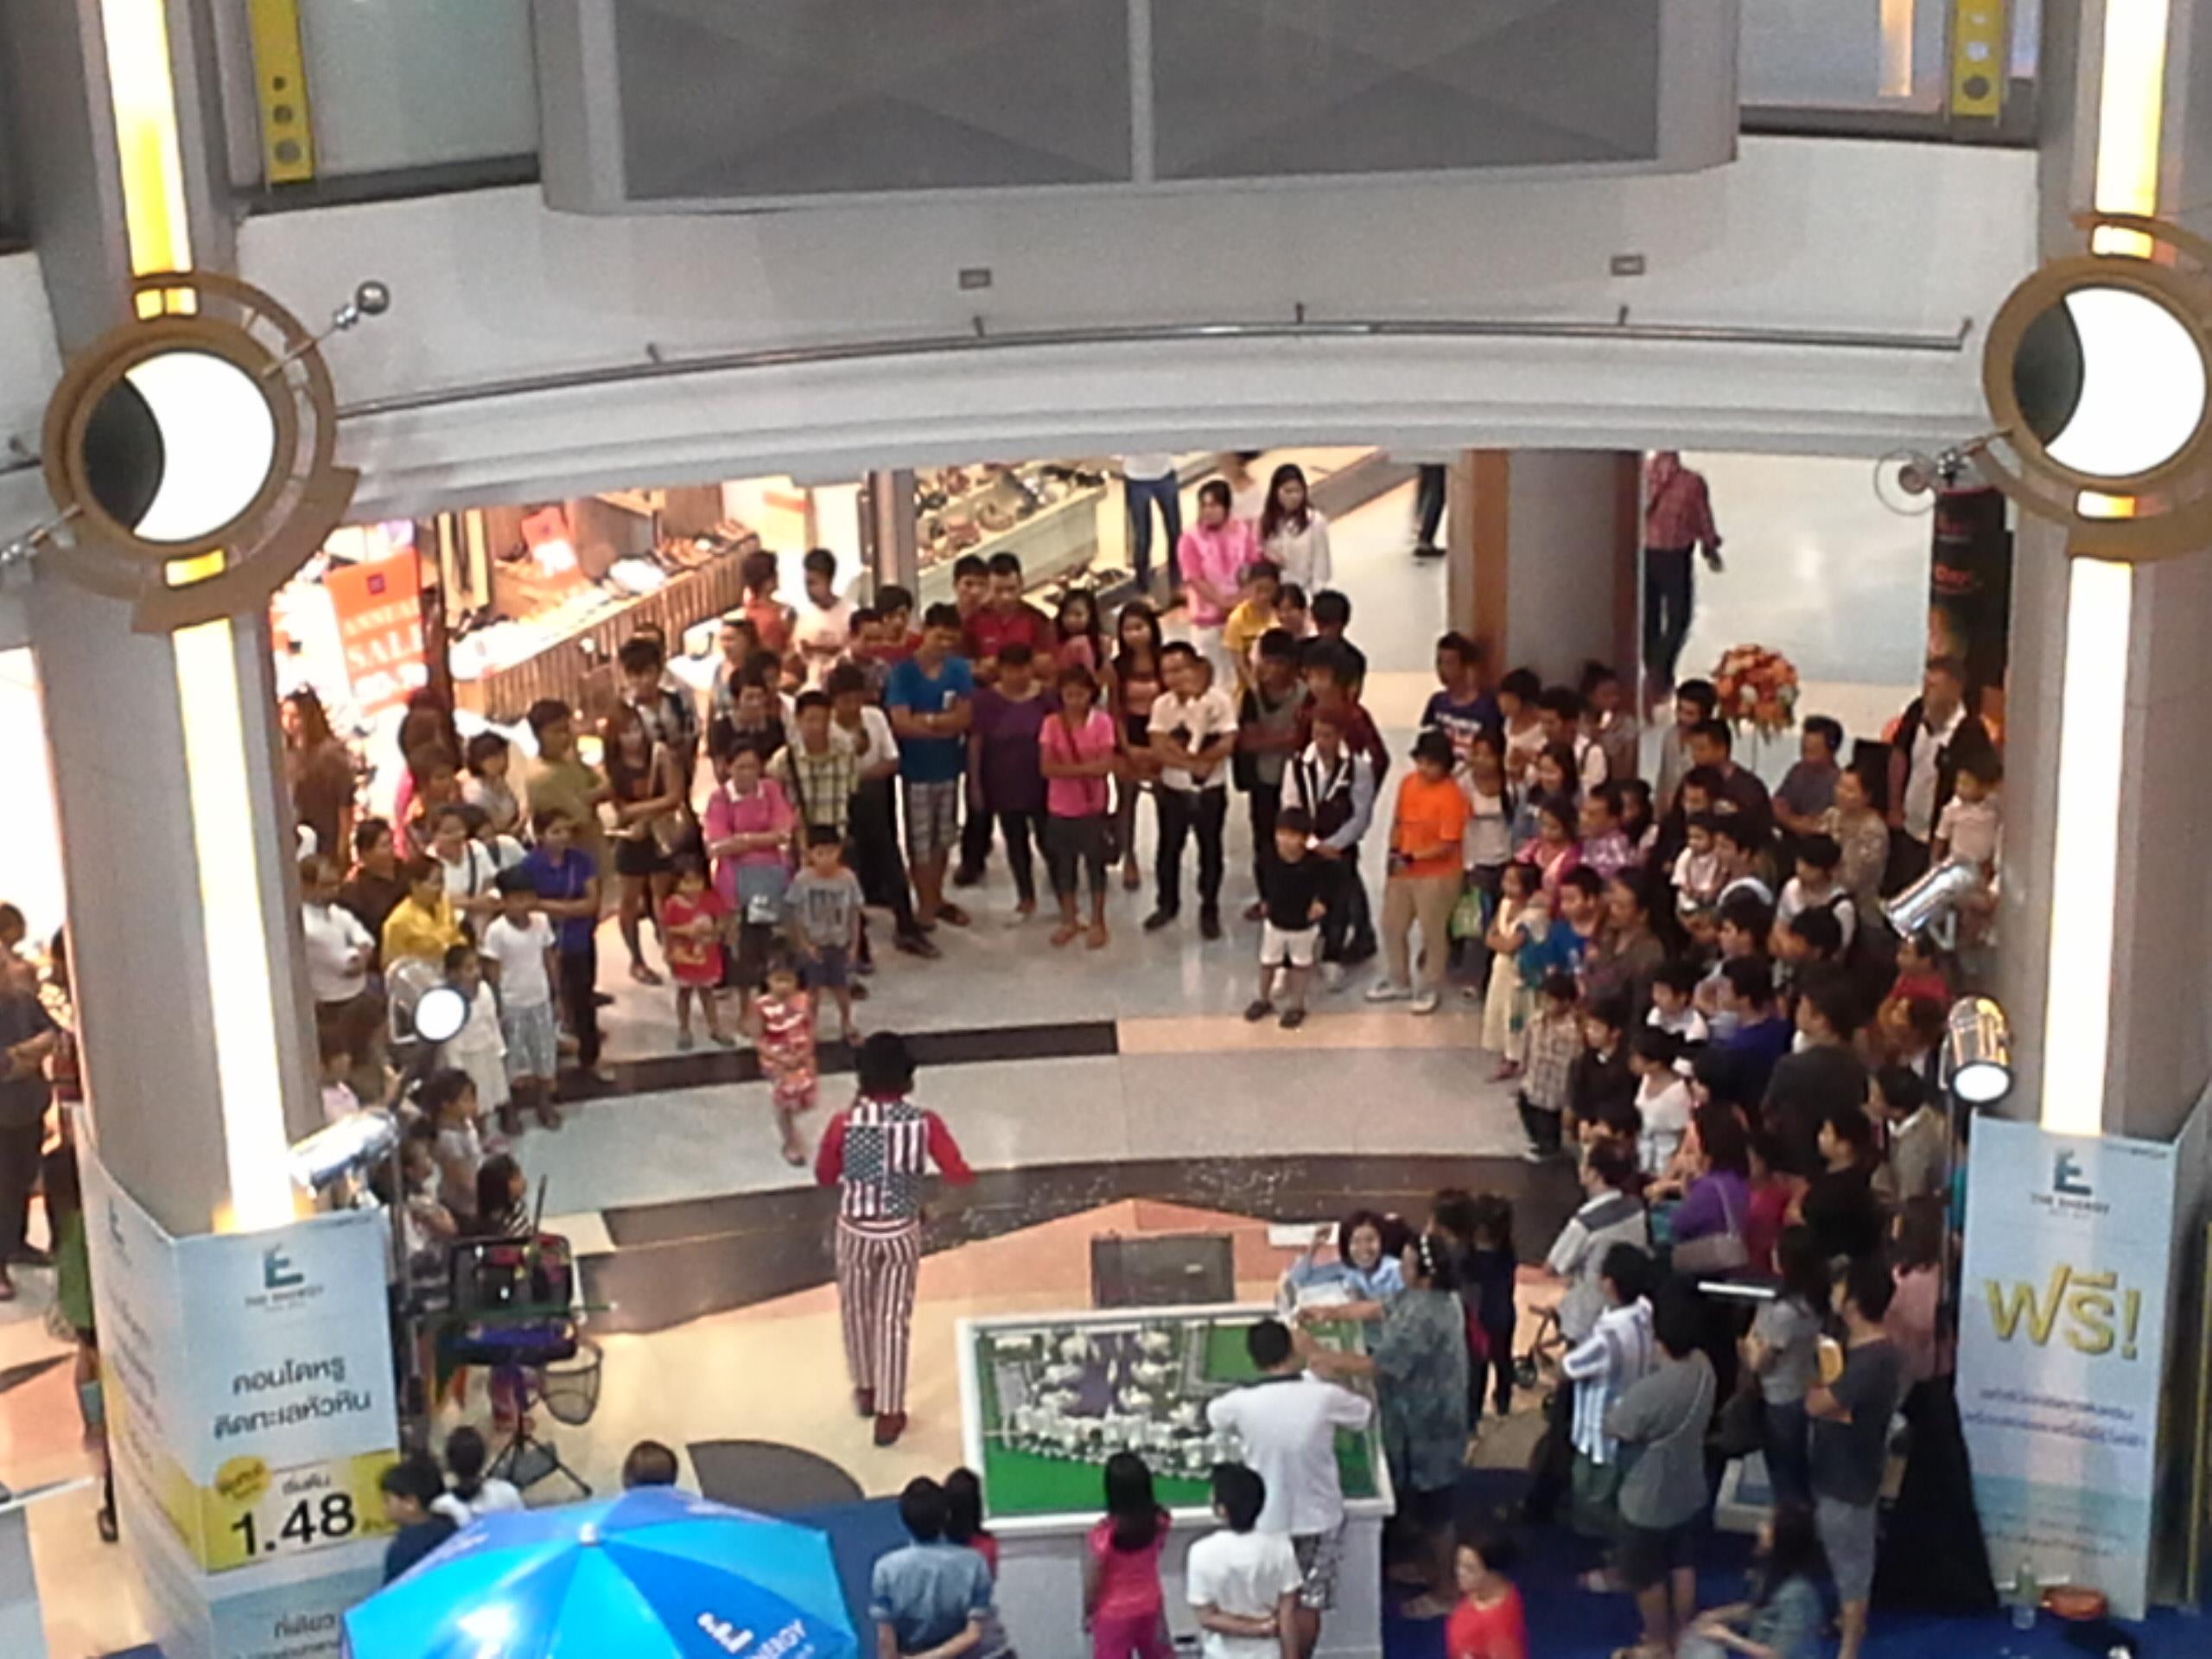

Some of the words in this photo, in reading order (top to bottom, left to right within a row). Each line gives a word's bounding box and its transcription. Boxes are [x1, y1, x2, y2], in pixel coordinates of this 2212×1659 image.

[1985, 1263, 2142, 1361] ฟรี!
[232, 1355, 346, 1395] คอนโดหรู
[231, 1491, 356, 1556] 1.48
